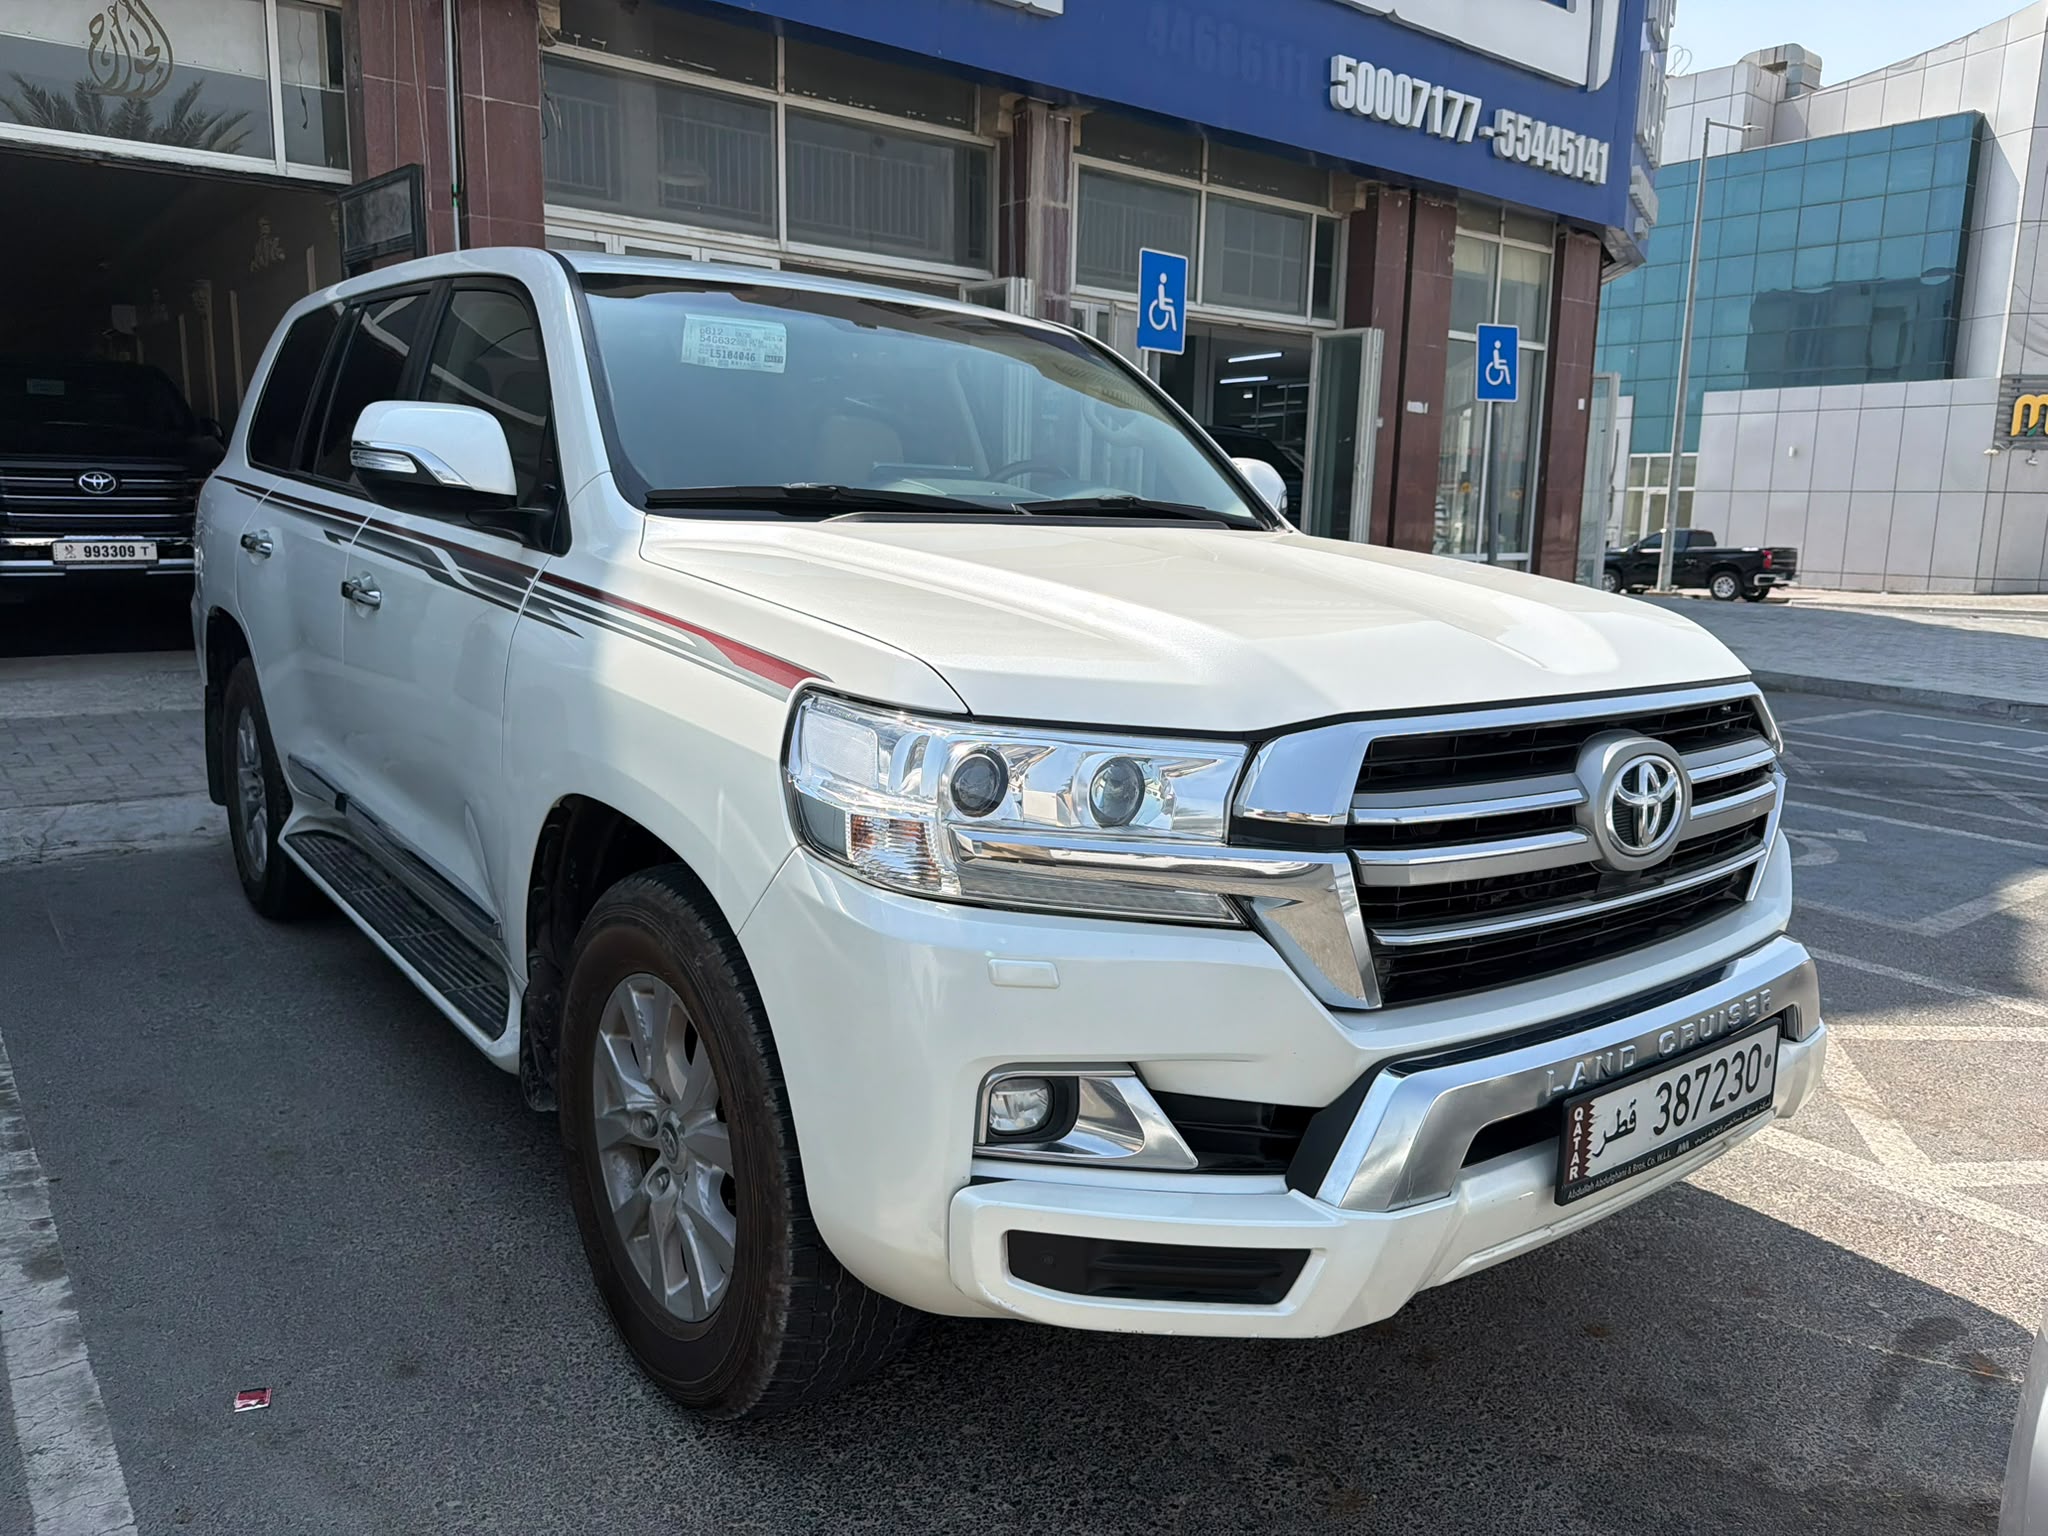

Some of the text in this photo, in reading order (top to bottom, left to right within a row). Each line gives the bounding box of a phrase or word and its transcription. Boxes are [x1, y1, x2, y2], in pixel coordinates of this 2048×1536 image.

[83, 545, 136, 558] 993309
[140, 546, 150, 556] T
[1545, 989, 1772, 1097] LAND CRUISER
[1653, 1043, 1762, 1136] 387230
[1569, 1107, 1584, 1181] QATAR
[1592, 1098, 1637, 1157] قطر
